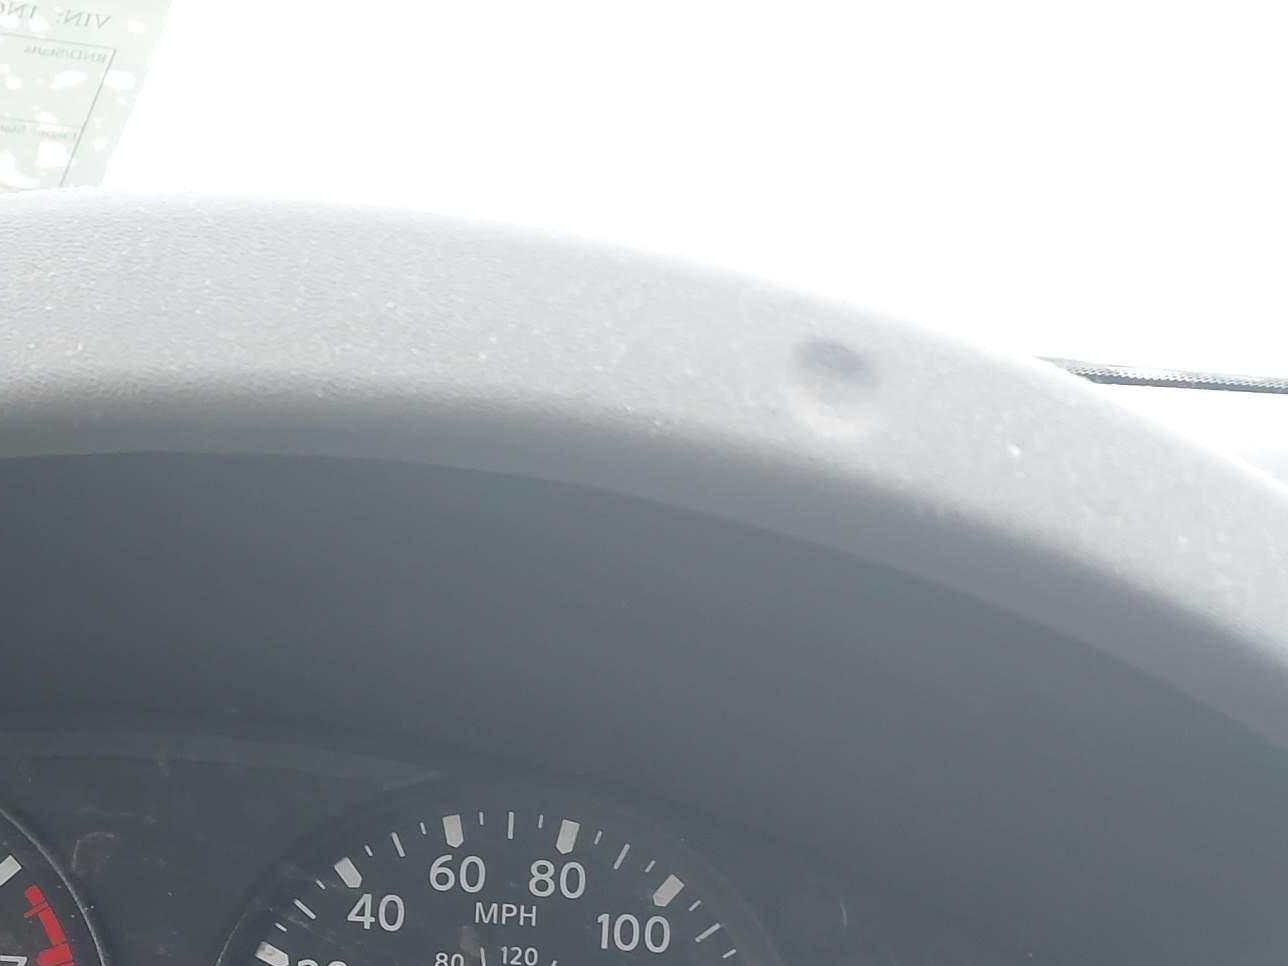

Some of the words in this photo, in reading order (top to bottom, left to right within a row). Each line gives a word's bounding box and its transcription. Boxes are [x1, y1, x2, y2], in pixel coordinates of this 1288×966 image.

[429, 854, 487, 894] 60
[528, 859, 586, 900] 80
[347, 893, 406, 933] 40
[475, 902, 538, 928] MPH
[597, 913, 671, 954] 100
[500, 946, 539, 966] 120
